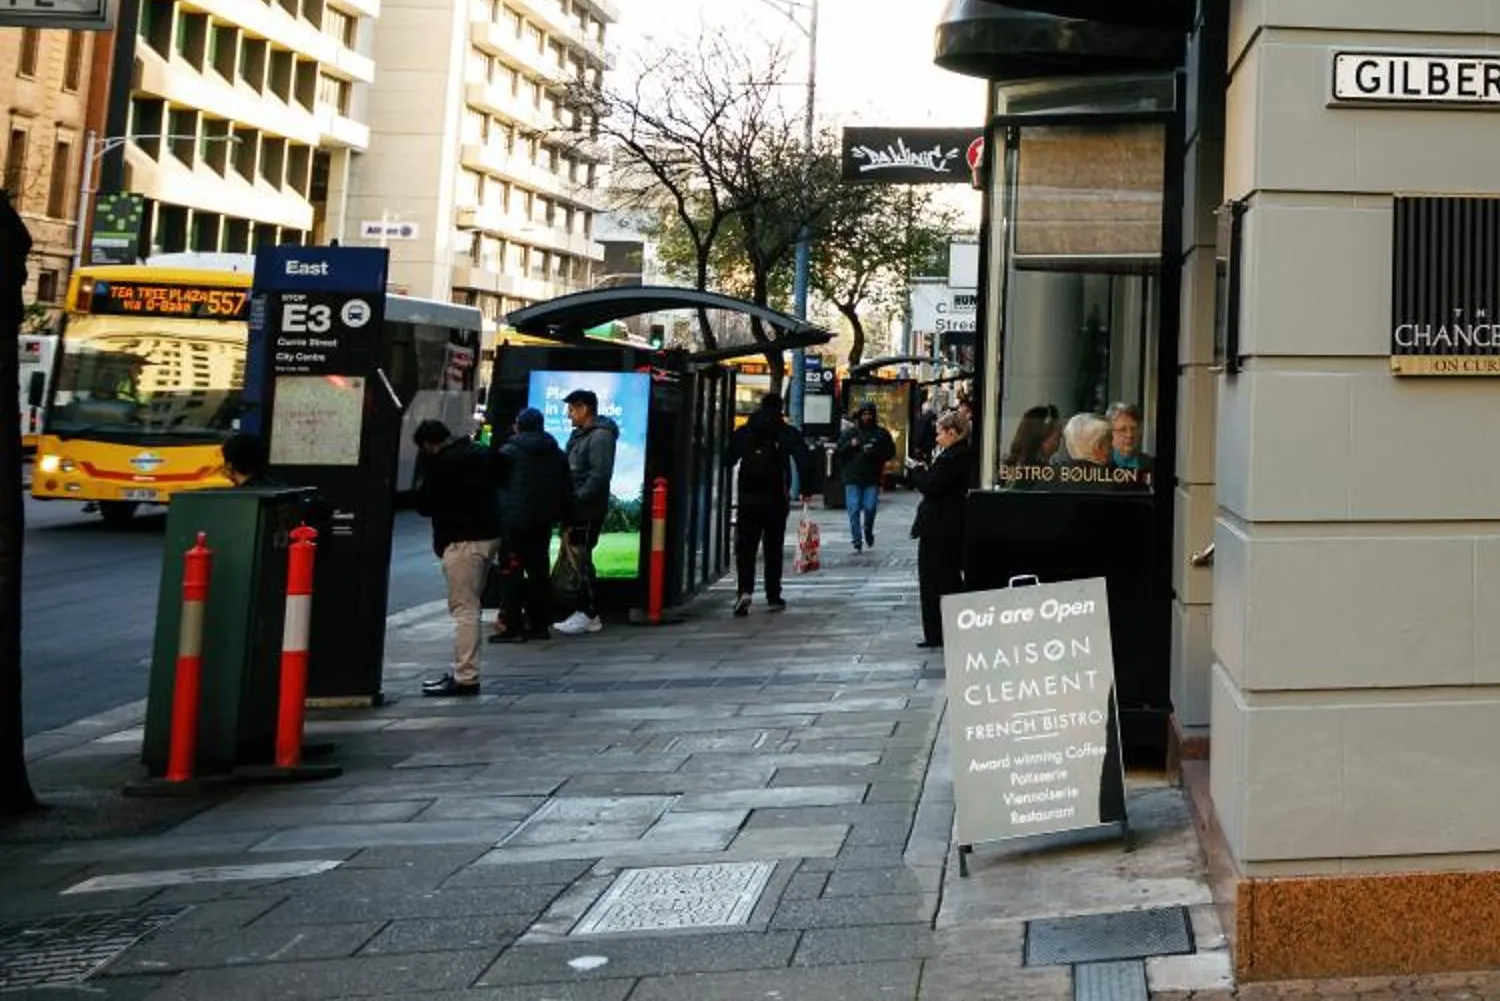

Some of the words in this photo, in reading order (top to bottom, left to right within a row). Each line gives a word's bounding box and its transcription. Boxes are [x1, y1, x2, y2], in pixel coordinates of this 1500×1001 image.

[285, 259, 329, 275] East
[207, 291, 246, 315] 557
[281, 303, 332, 333] E3
[1434, 360, 1459, 372] ON
[957, 606, 995, 630] Oui
[1000, 607, 1034, 624] are
[1039, 599, 1095, 623] Open
[964, 669, 1098, 705] CLEMENT
[965, 719, 1036, 741] FRENCH
[1043, 710, 1103, 731] BISTRO
[969, 752, 1011, 773] Award
[1014, 749, 1064, 766] winning
[1065, 742, 1107, 759] Coffee
[1010, 806, 1075, 825] Restaurant
